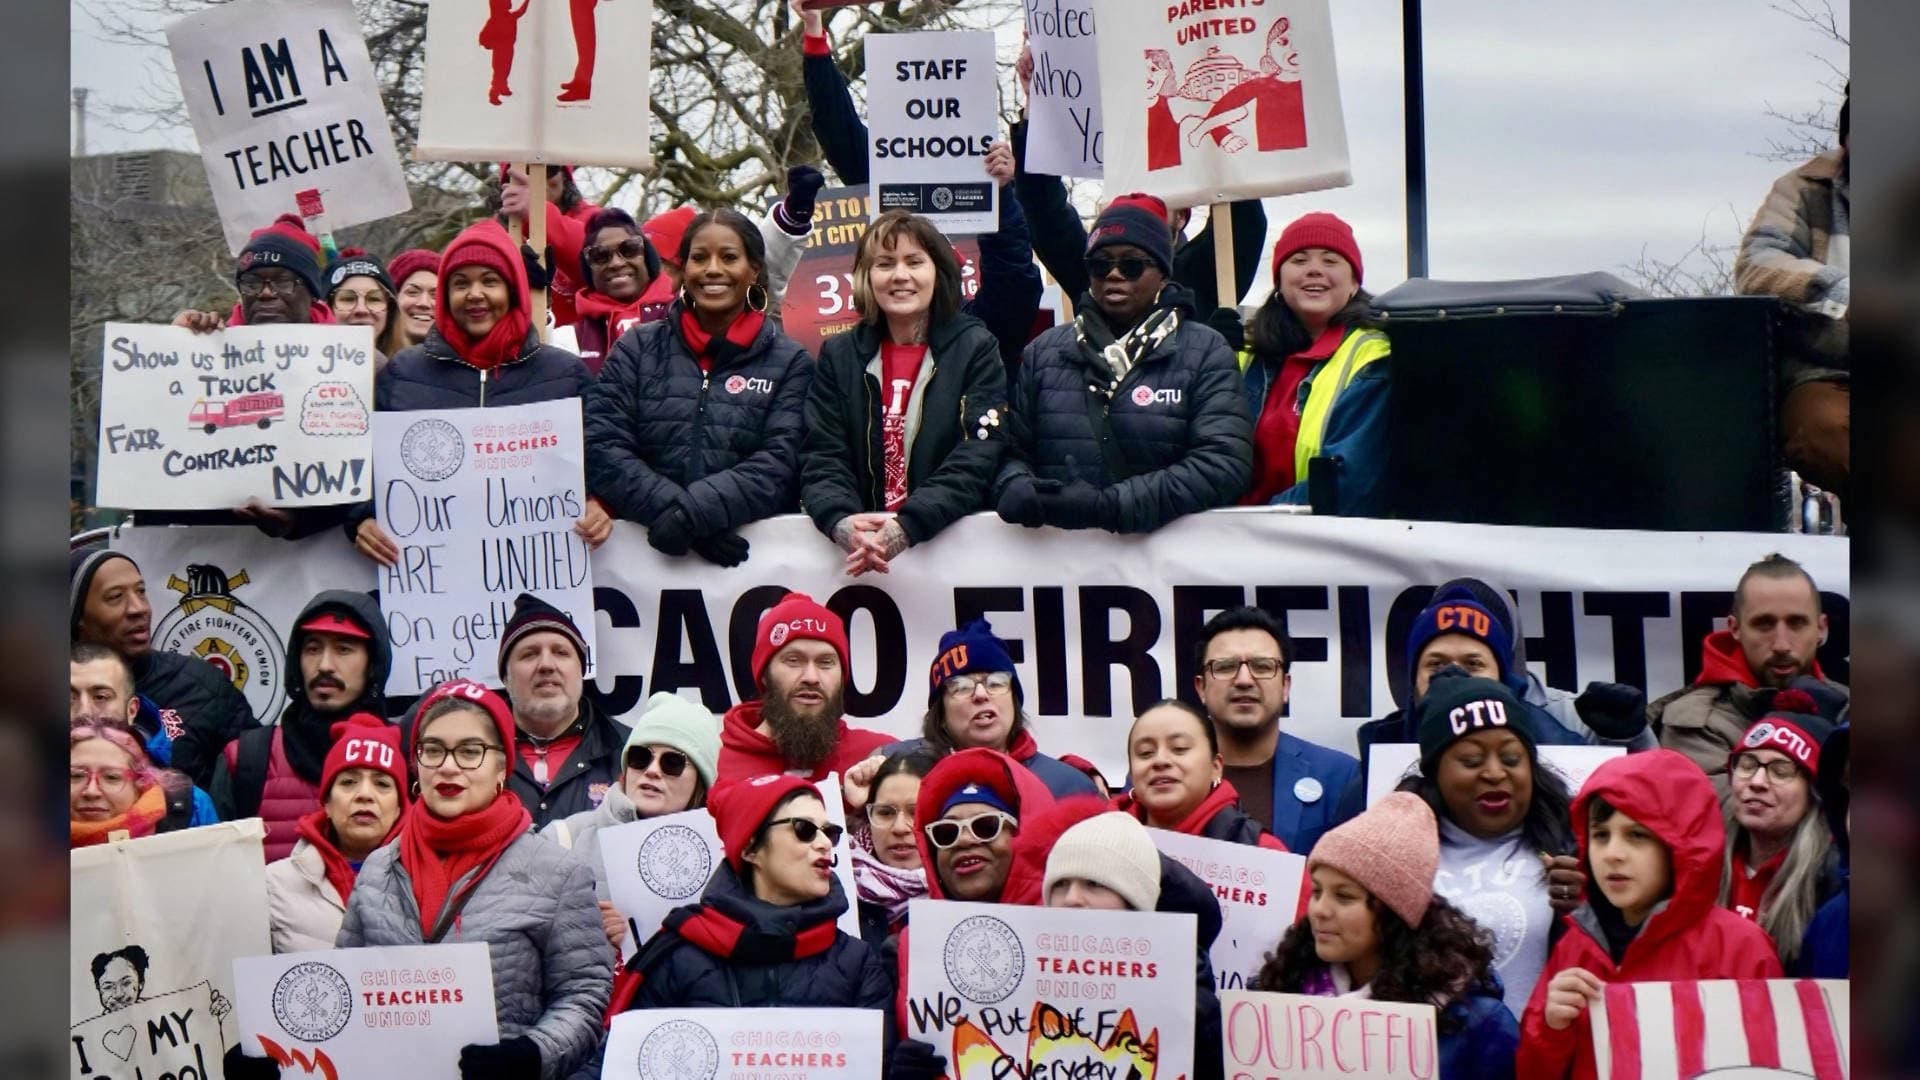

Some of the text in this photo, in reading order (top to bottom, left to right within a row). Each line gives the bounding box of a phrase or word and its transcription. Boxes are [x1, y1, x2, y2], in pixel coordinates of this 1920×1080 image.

[1176, 17, 1256, 46] UNITED
[204, 29, 348, 115] I AM A
[896, 59, 967, 82] STAFF
[906, 98, 961, 120] OUR
[875, 135, 993, 159] SCHOOLS
[1069, 107, 1104, 164] Yo
[225, 119, 374, 190] TEACHER
[836, 197, 861, 218] TO
[827, 223, 867, 246] CITY
[816, 275, 843, 315] 3
[111, 337, 366, 374] Show us that you give
[169, 373, 276, 397] a TRUCK
[319, 386, 348, 399] CTU
[746, 377, 773, 394] CTU
[1155, 389, 1181, 403] CTU
[105, 424, 164, 454] FAIR
[474, 435, 558, 454] TEACHERS
[163, 444, 277, 477] CONTRACTS
[273, 459, 365, 500] NOW!
[386, 476, 581, 537] Our Unions
[388, 531, 588, 594] ARE UNITED
[388, 611, 434, 648] On
[790, 618, 827, 632] CTU
[1437, 606, 1490, 637] CTU
[180, 617, 270, 686] FIRE FIGHTERS UNION
[932, 644, 968, 688] CTU
[1449, 700, 1507, 735] CTU
[345, 738, 394, 768] CTU
[1774, 727, 1811, 761] CTU
[1170, 856, 1265, 886] ICAGO
[1433, 859, 1527, 896] CTU
[1036, 933, 1152, 956] CHICAGO
[361, 968, 457, 986] CHICAGO
[1037, 957, 1158, 978] TEACHERS
[363, 987, 464, 1006] TEACHERS
[1037, 979, 1116, 1000] UNION
[365, 1010, 432, 1027] UNION
[910, 991, 967, 1034] We
[979, 1006, 1034, 1036] Put
[1038, 1002, 1093, 1041] Out
[72, 1035, 93, 1075] I
[147, 1008, 194, 1055] MY
[731, 1031, 842, 1048] CHICAGO
[732, 1052, 848, 1068] TEACHERS
